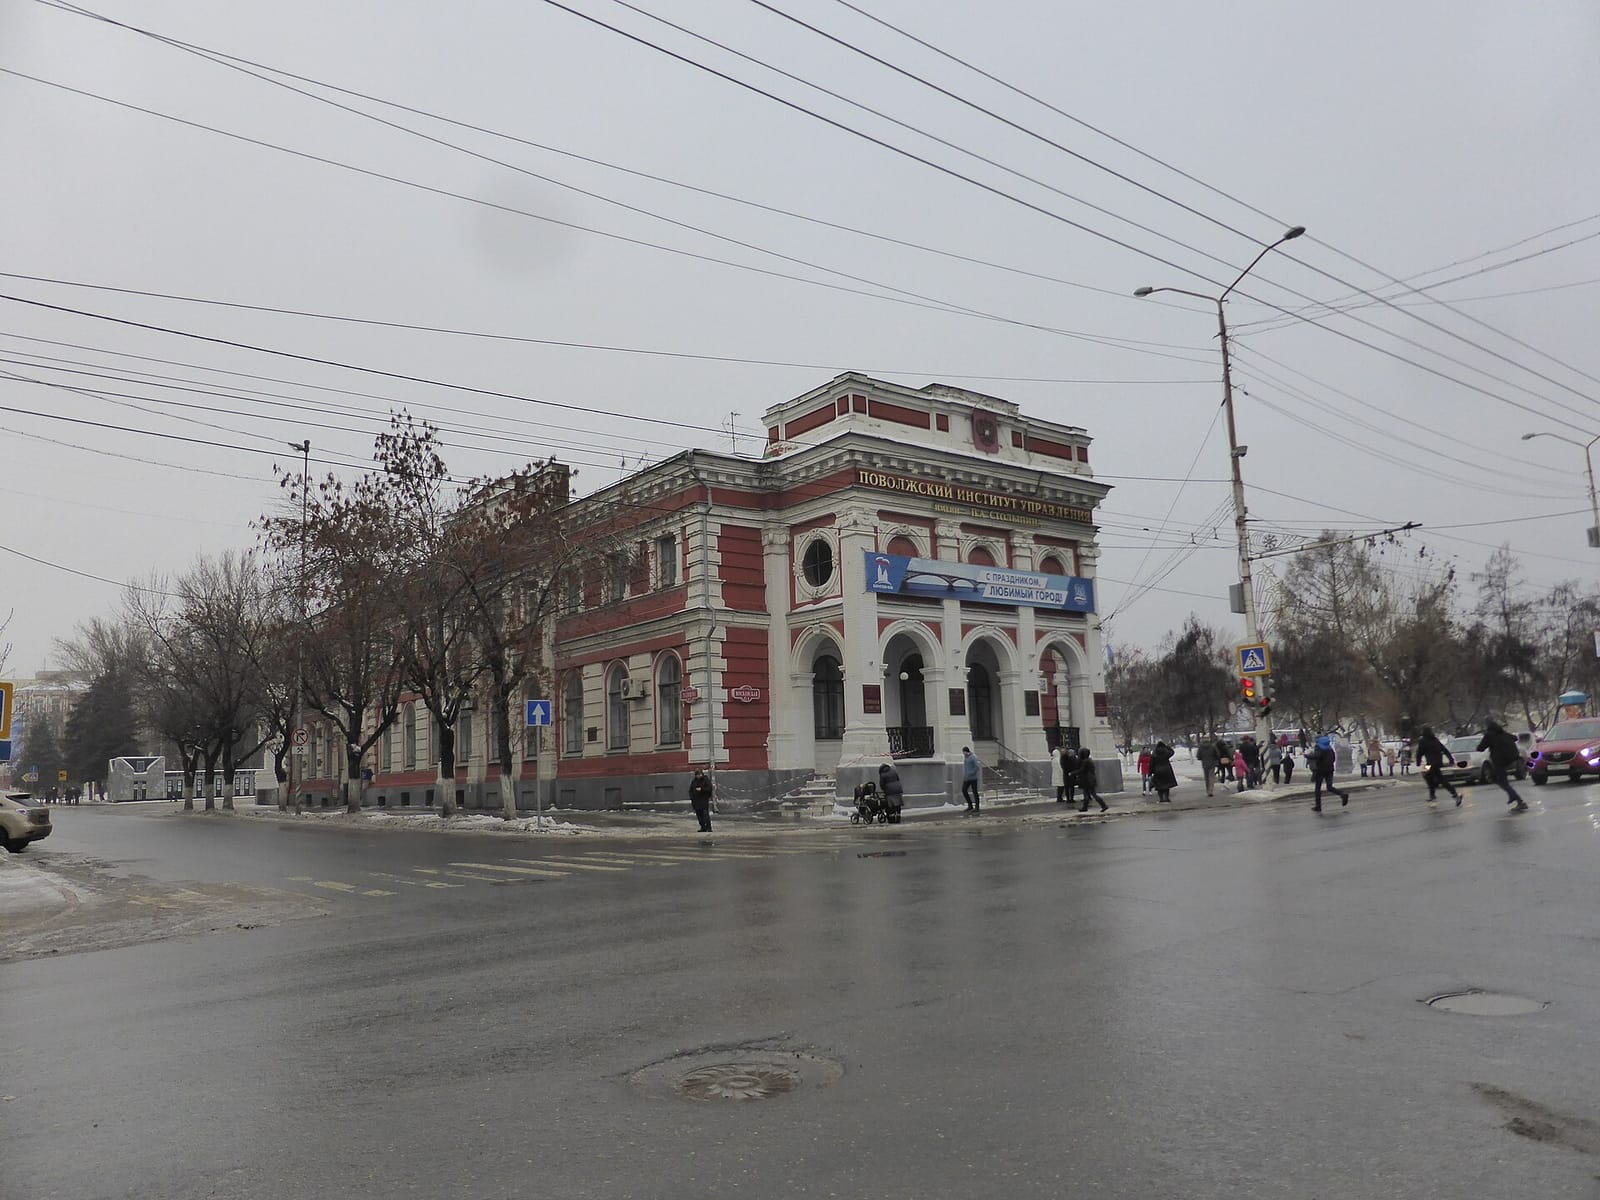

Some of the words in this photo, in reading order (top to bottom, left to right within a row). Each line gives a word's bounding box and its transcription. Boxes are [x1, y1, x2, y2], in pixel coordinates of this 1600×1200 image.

[957, 488, 1017, 509] ИНСТИТУТ
[1020, 499, 1091, 522] УПРАВЛЕНИЯ
[985, 572, 990, 581] С
[992, 573, 1041, 587] ПРАЗДНИКОМ,
[990, 586, 1034, 599] ЛЮБИМЫЙ
[1035, 590, 1063, 603] ГОРОД!
